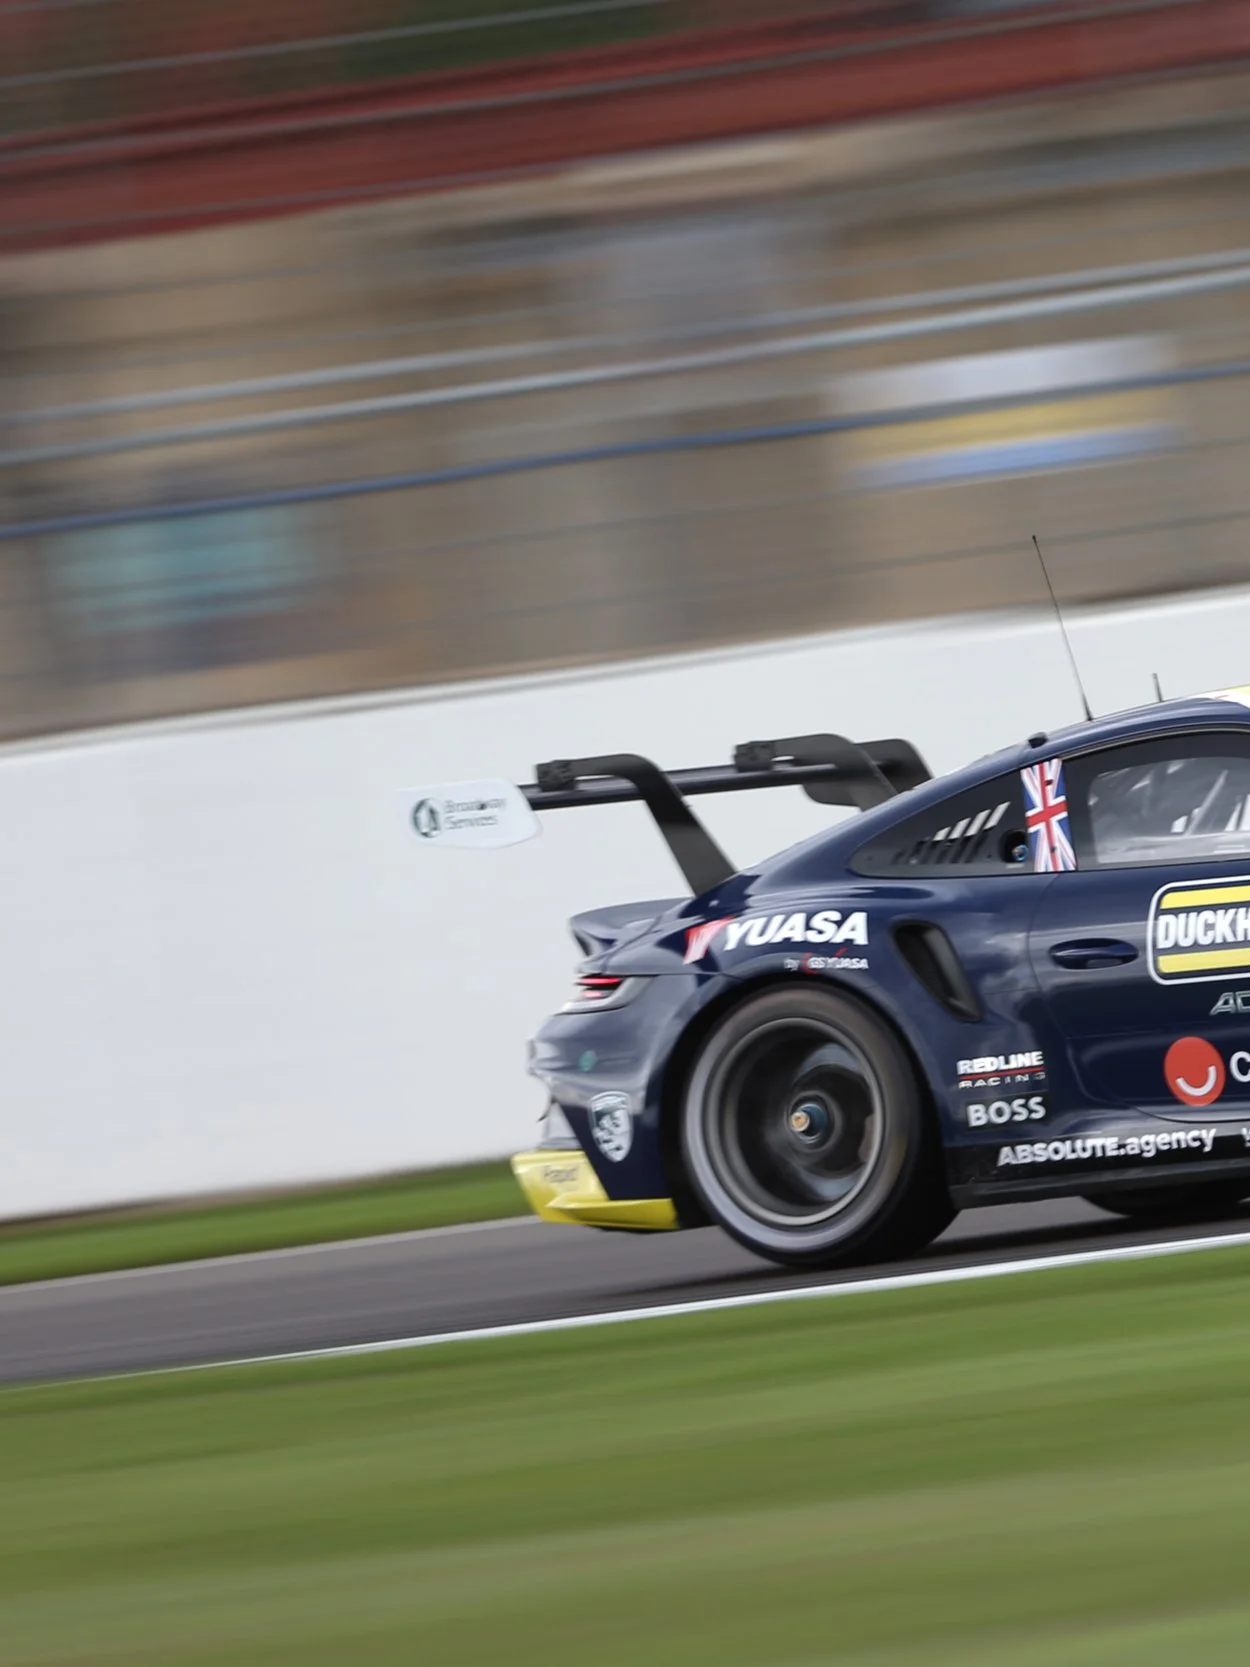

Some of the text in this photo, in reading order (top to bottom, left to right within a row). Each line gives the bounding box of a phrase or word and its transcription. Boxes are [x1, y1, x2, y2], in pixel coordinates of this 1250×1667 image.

[724, 911, 869, 951] YUASA
[957, 1051, 1044, 1075] REDLINE
[967, 1096, 1046, 1127] BOSS
[997, 1128, 1217, 1167] ABSOLUTE.agency
